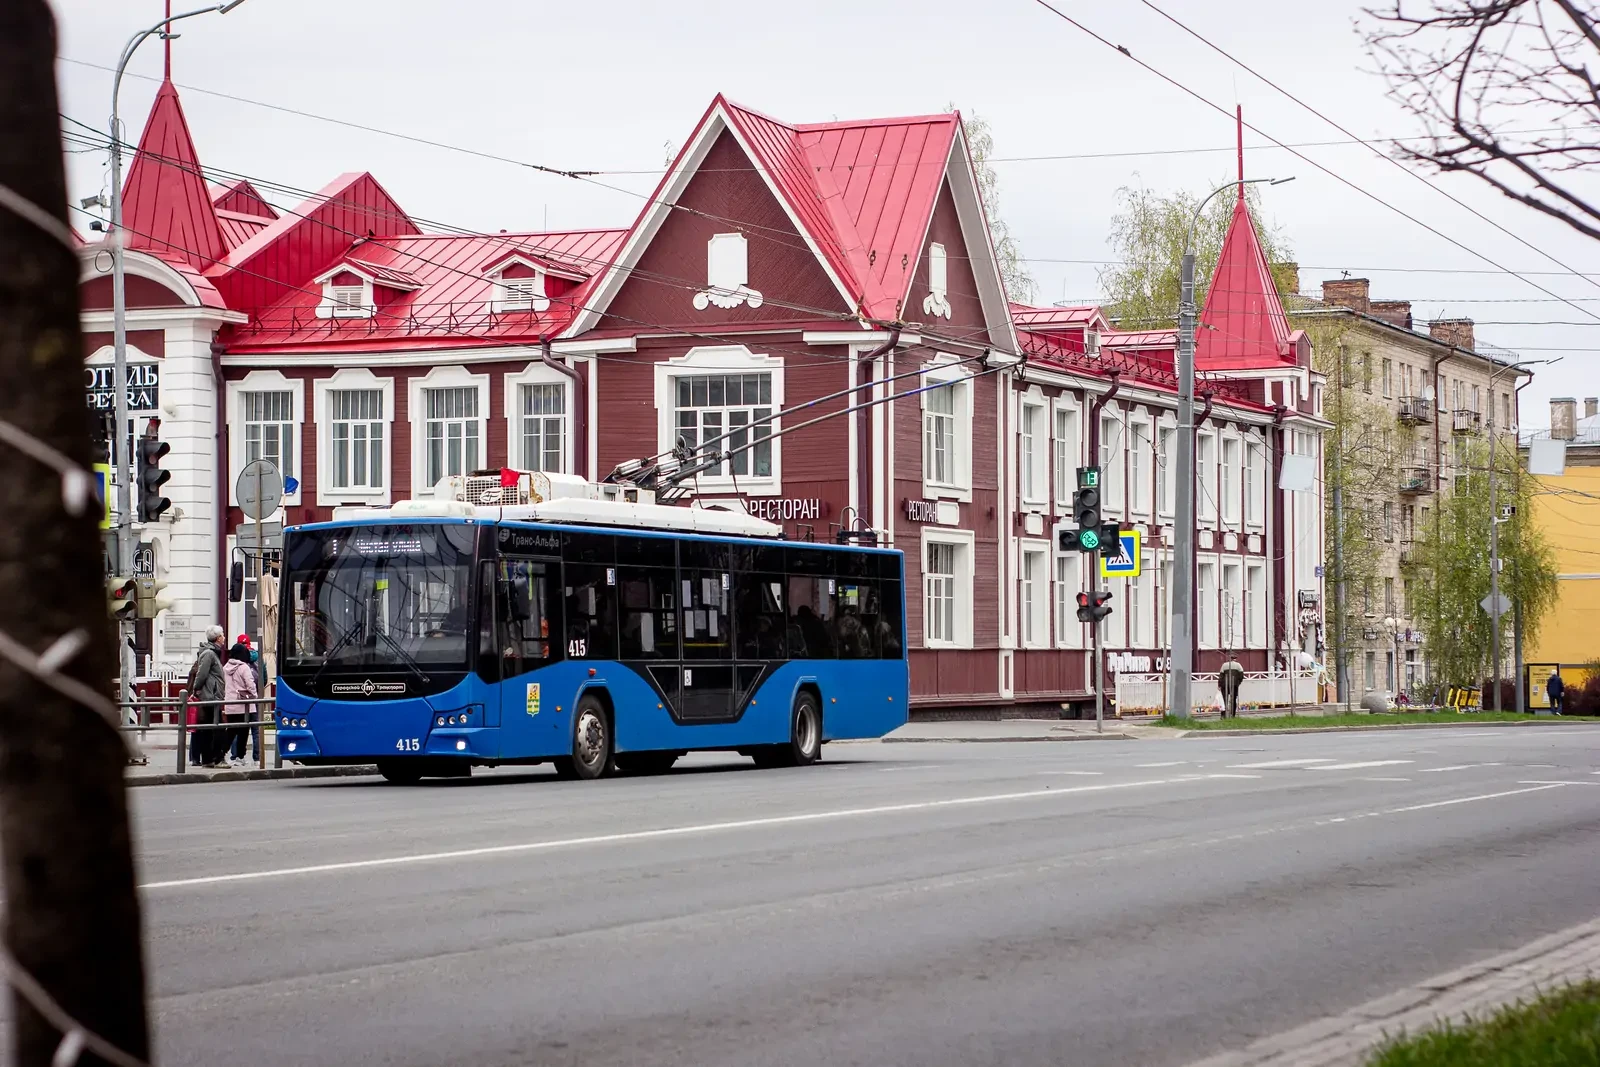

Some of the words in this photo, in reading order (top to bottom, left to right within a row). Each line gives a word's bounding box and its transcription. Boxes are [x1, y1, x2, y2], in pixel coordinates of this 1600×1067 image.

[1087, 472, 1098, 485] 13
[749, 498, 819, 520] РЕСТОРАН
[908, 500, 937, 522] РЕСТОРАН
[511, 532, 560, 551] Транс-Альфа
[568, 638, 586, 657] 415
[395, 738, 421, 751] 415
